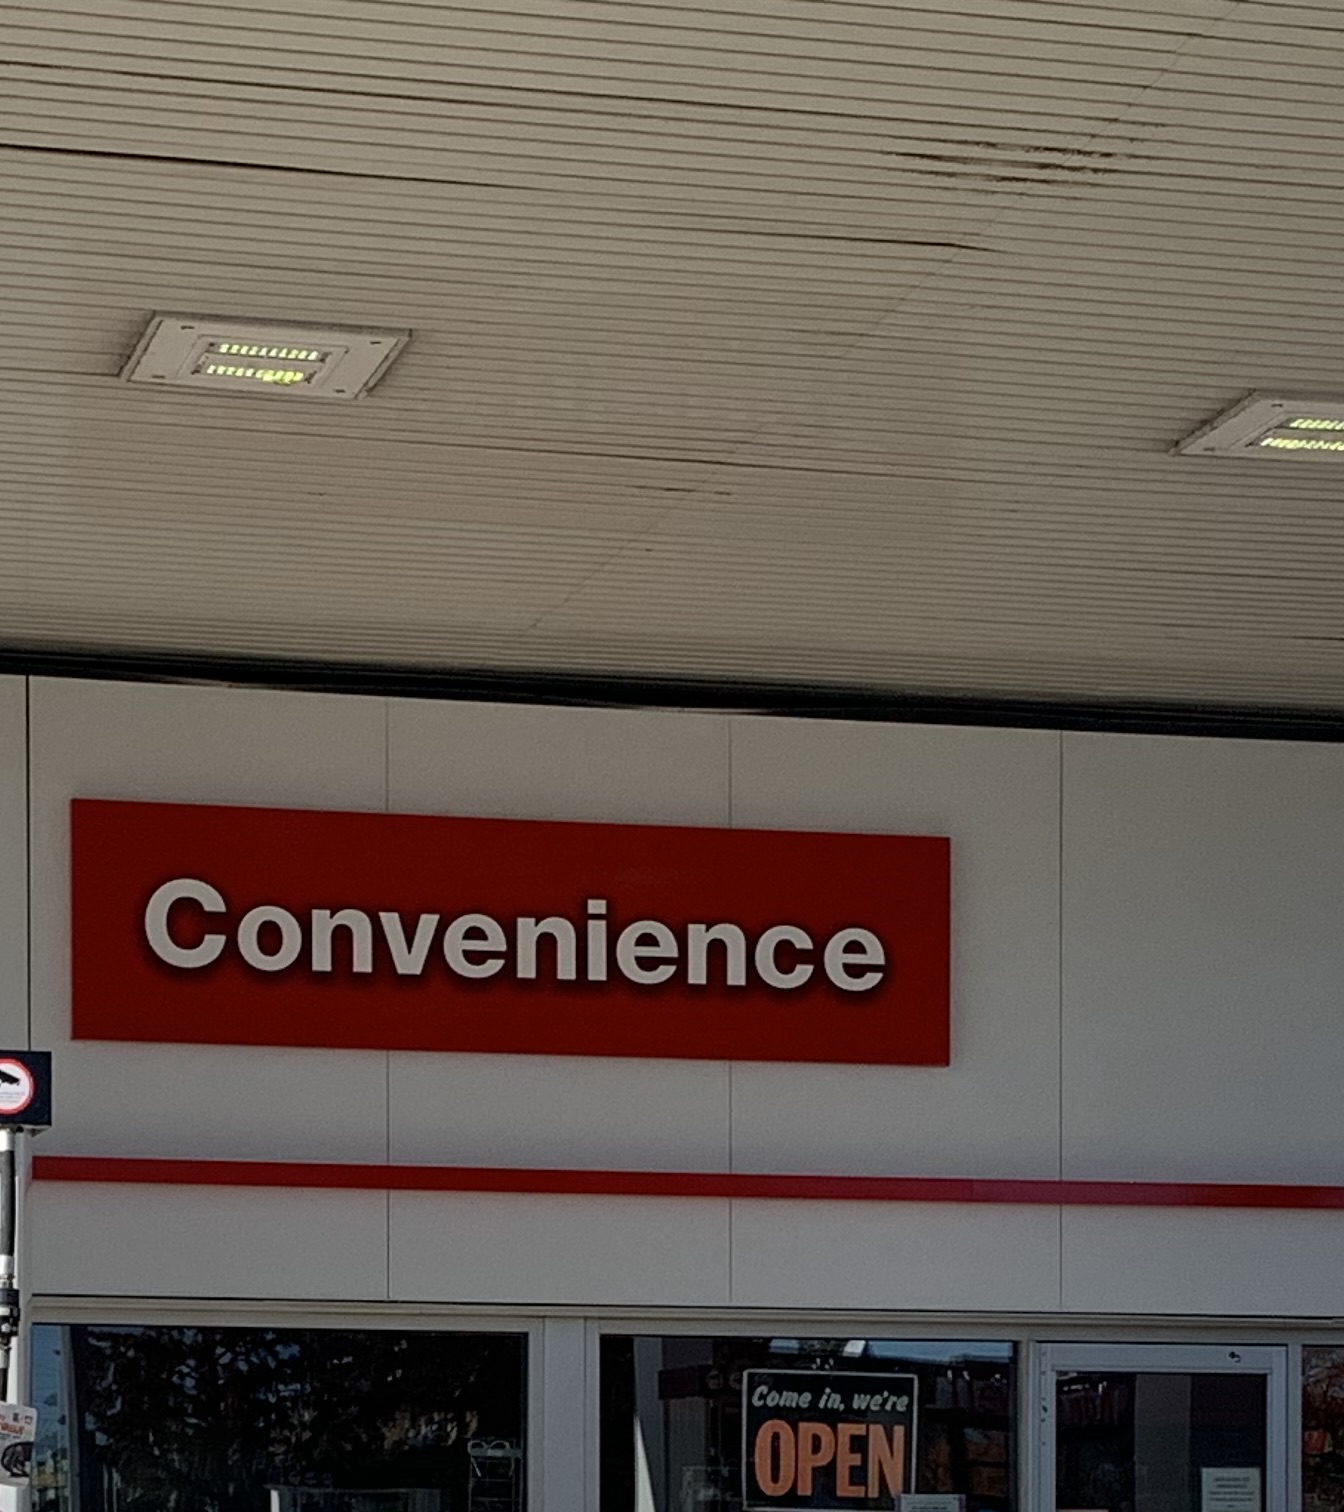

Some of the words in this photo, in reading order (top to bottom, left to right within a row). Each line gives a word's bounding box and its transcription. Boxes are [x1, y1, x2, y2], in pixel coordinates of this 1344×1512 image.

[144, 877, 887, 991] Convenience
[751, 1384, 812, 1408] Come
[818, 1386, 845, 1412] in,
[852, 1390, 909, 1412] we're
[754, 1418, 905, 1498] OPEN
